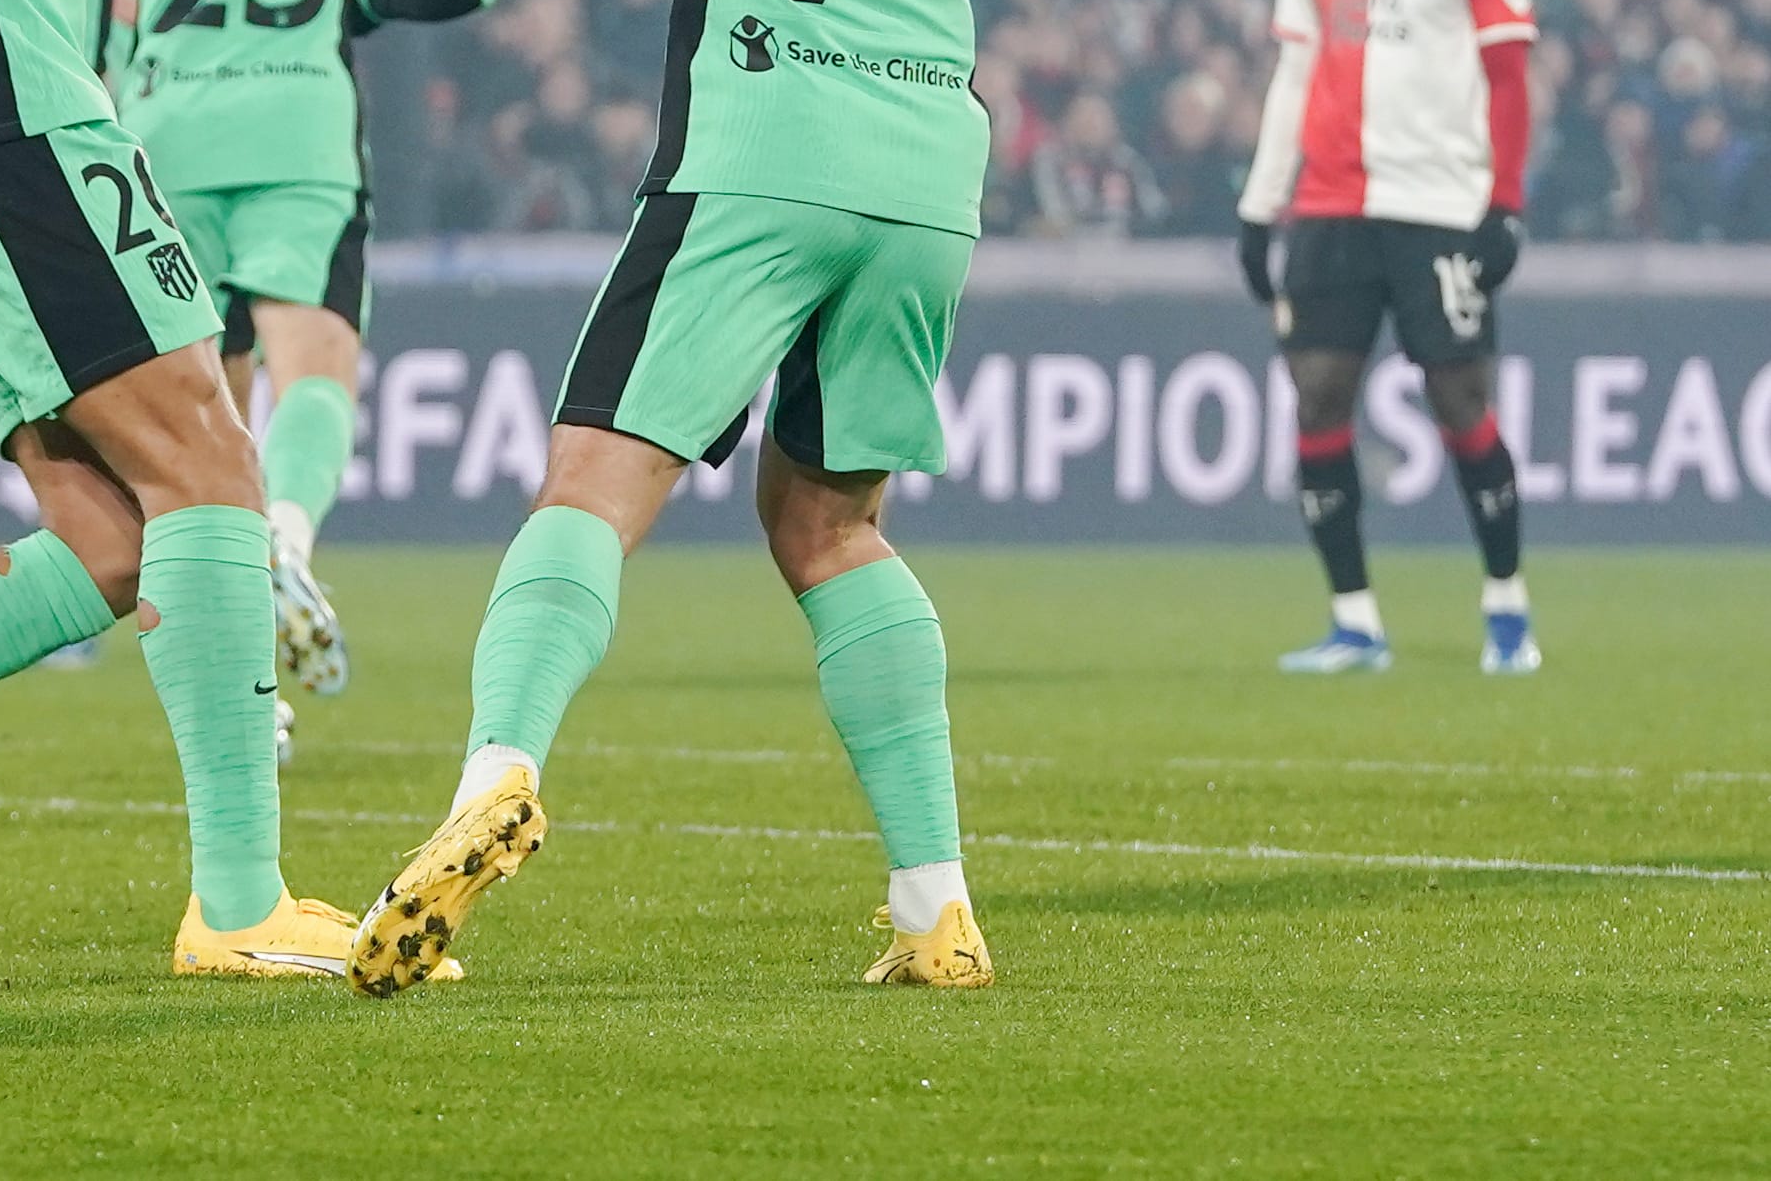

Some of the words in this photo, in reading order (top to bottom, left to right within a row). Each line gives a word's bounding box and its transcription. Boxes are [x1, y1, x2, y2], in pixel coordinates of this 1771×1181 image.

[786, 41, 846, 68] Save
[850, 54, 881, 77] the
[886, 59, 966, 90] Children
[248, 348, 550, 502] FA
